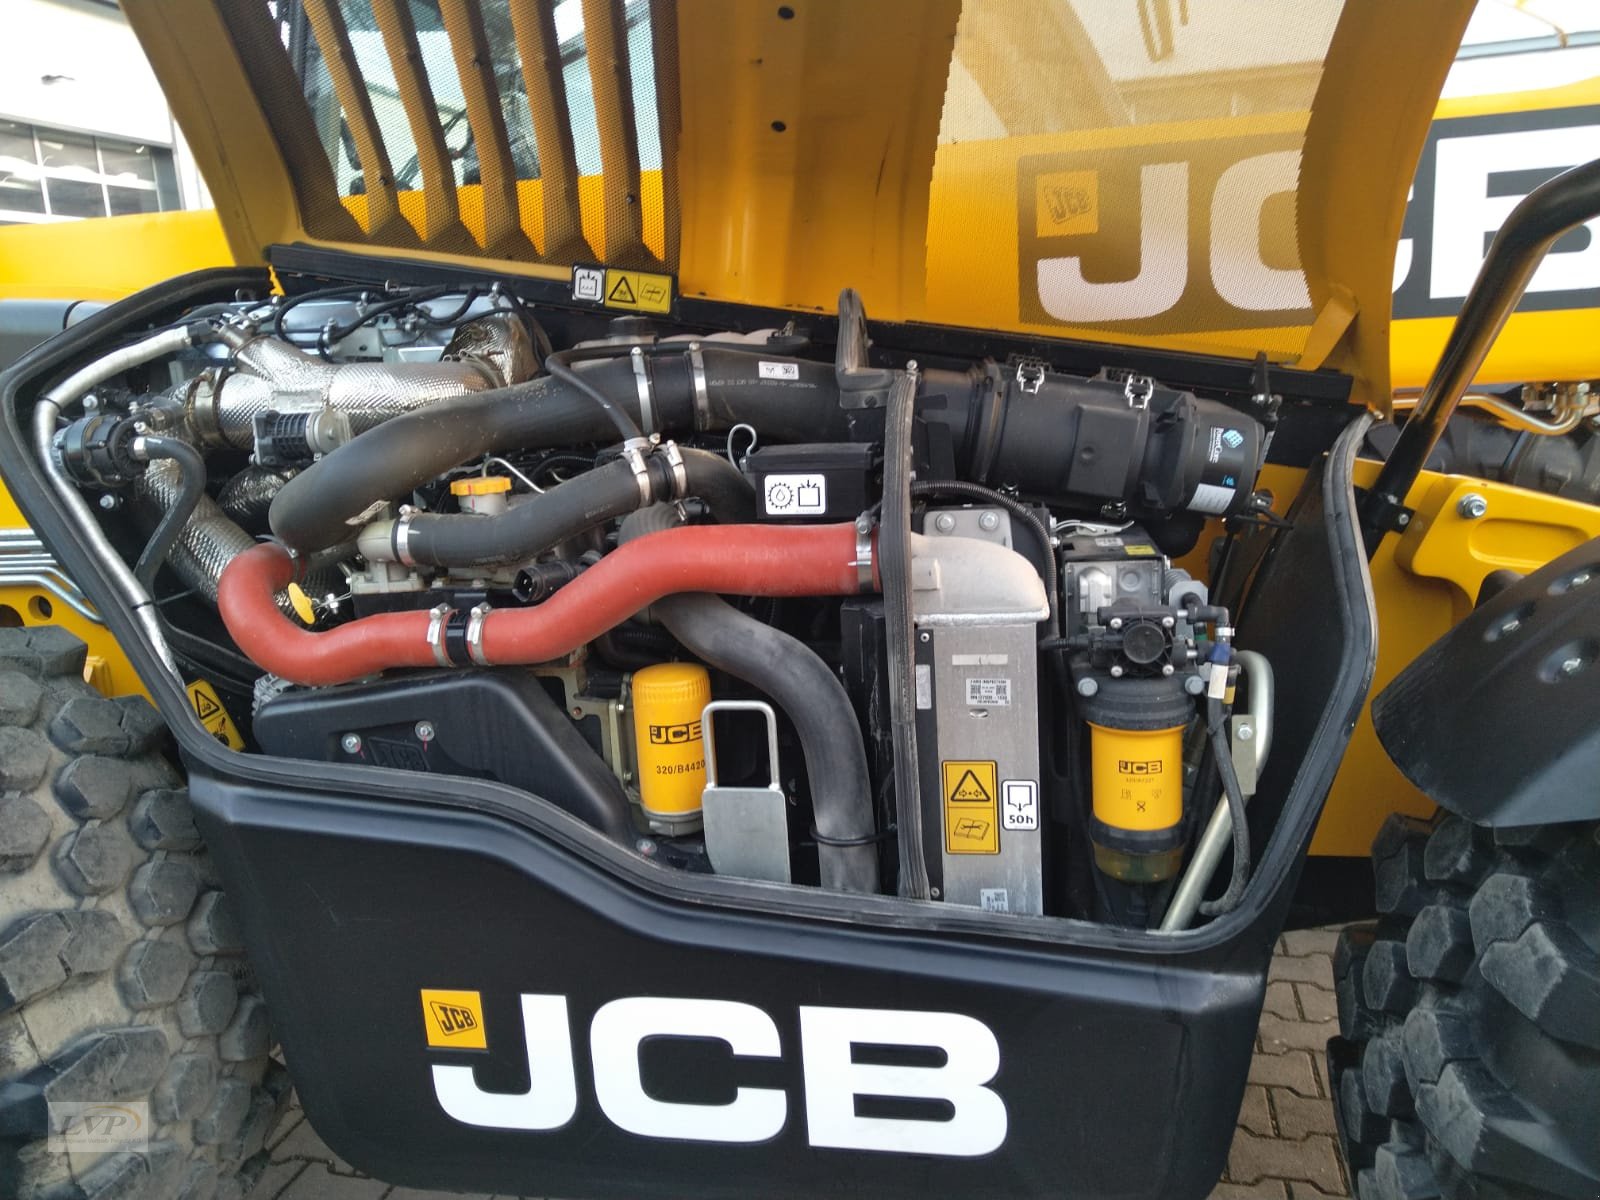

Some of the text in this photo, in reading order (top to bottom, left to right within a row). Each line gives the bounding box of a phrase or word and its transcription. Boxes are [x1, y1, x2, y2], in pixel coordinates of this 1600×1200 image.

[656, 759, 706, 775] 320/B4420
[1119, 761, 1162, 775] JCB
[438, 1005, 475, 1032] JCB
[432, 993, 1008, 1157] JCB
